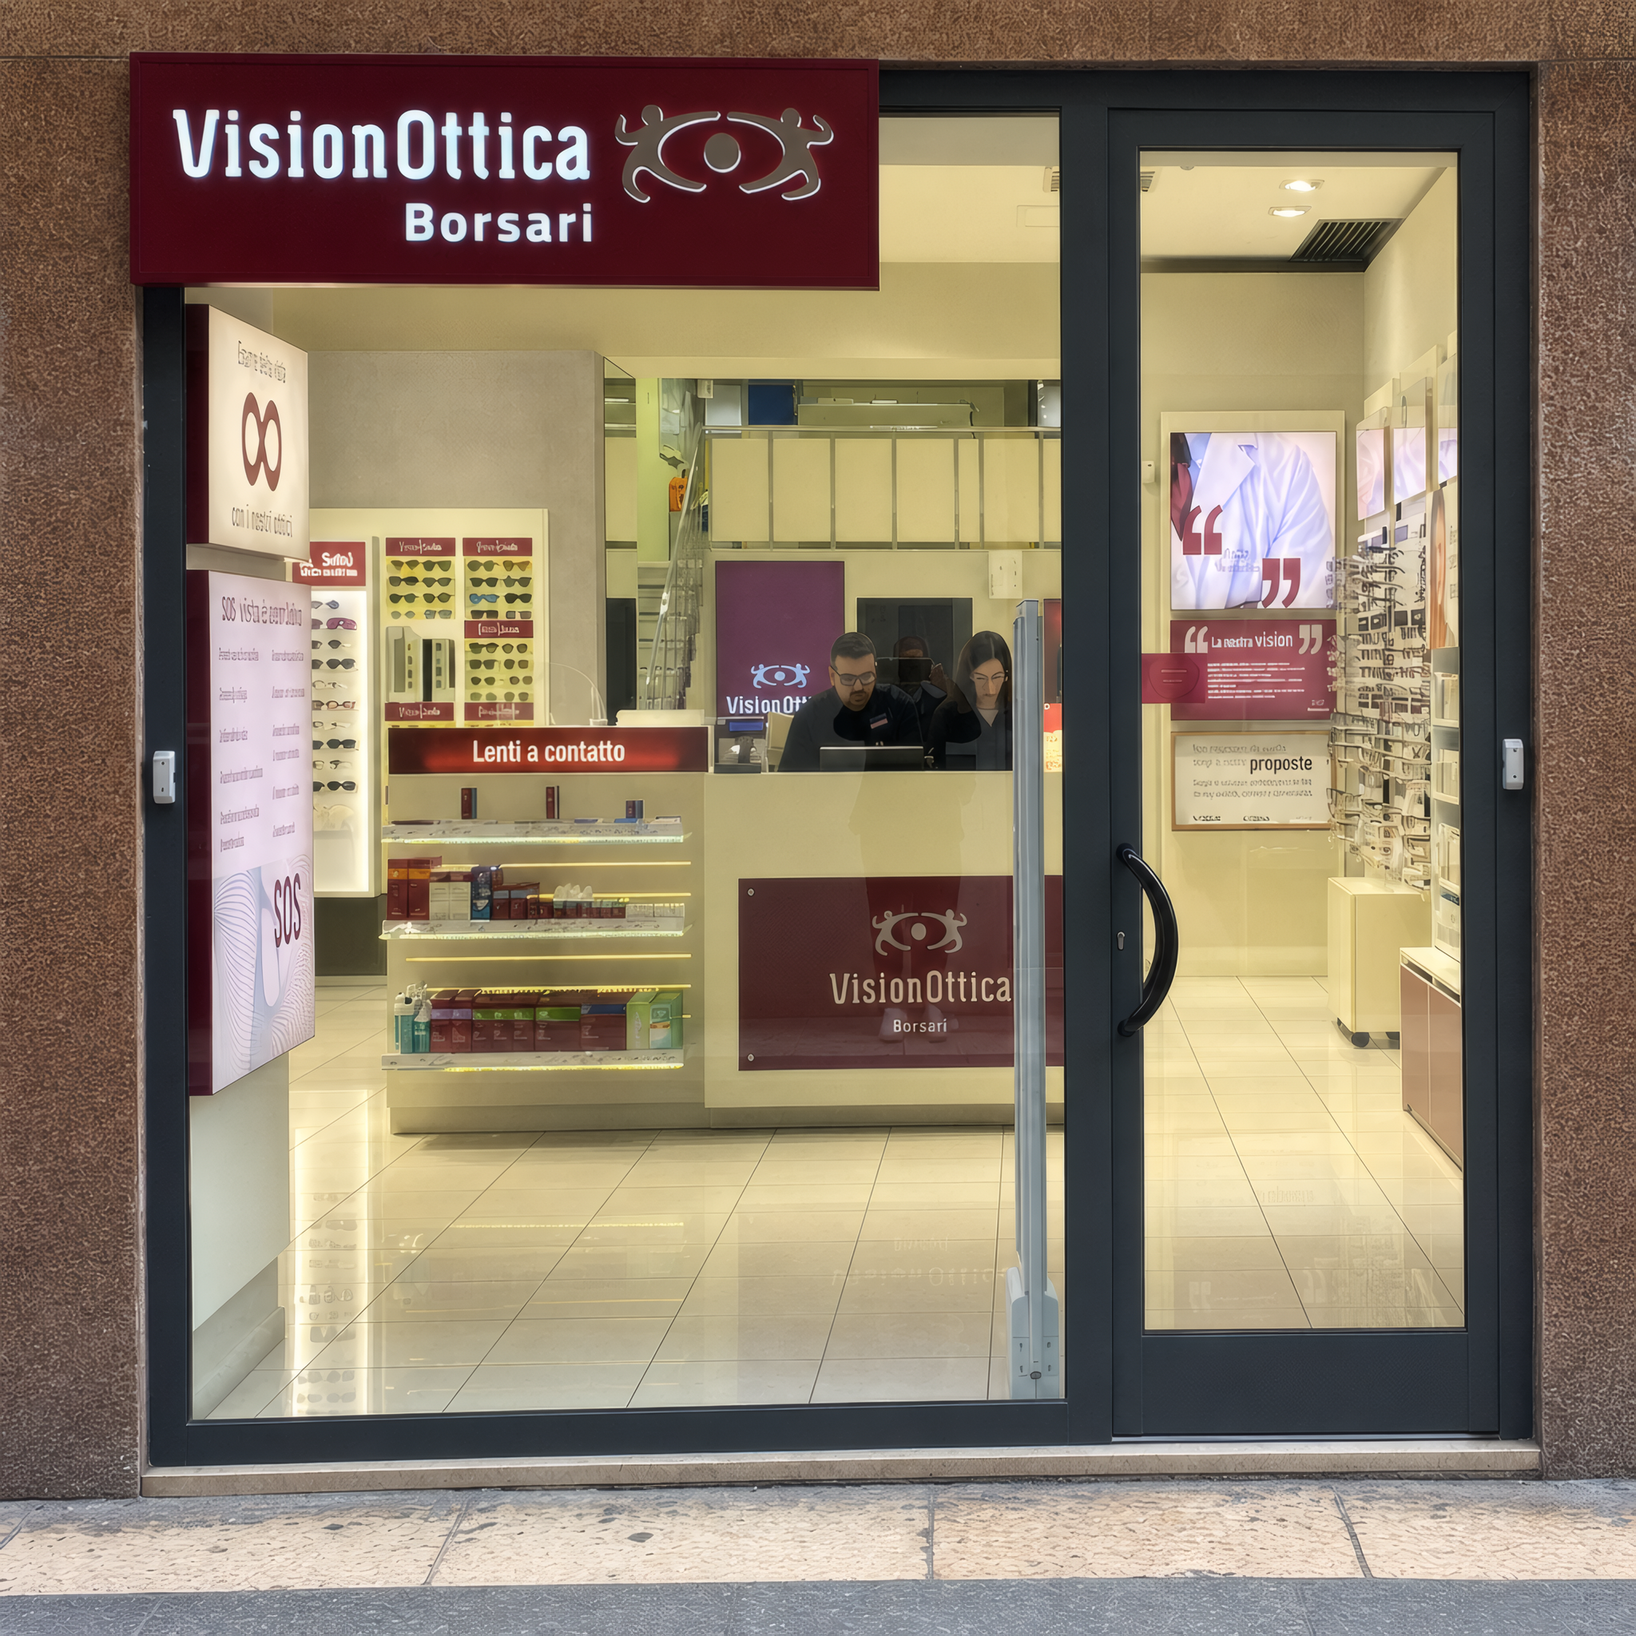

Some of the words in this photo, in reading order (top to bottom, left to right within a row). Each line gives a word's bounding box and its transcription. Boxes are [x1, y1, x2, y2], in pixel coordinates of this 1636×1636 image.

[172, 108, 591, 181] VisionOttica
[404, 202, 594, 243] Borsari
[1254, 631, 1293, 648] vision
[726, 695, 812, 714] VisionOt
[473, 740, 521, 763] Lenti
[527, 744, 539, 763] a
[544, 740, 626, 763] contatto
[1250, 755, 1313, 775] proposte
[274, 872, 301, 949] SOS
[829, 970, 1012, 1005] VisionOttica
[893, 1018, 948, 1033] Borsari
